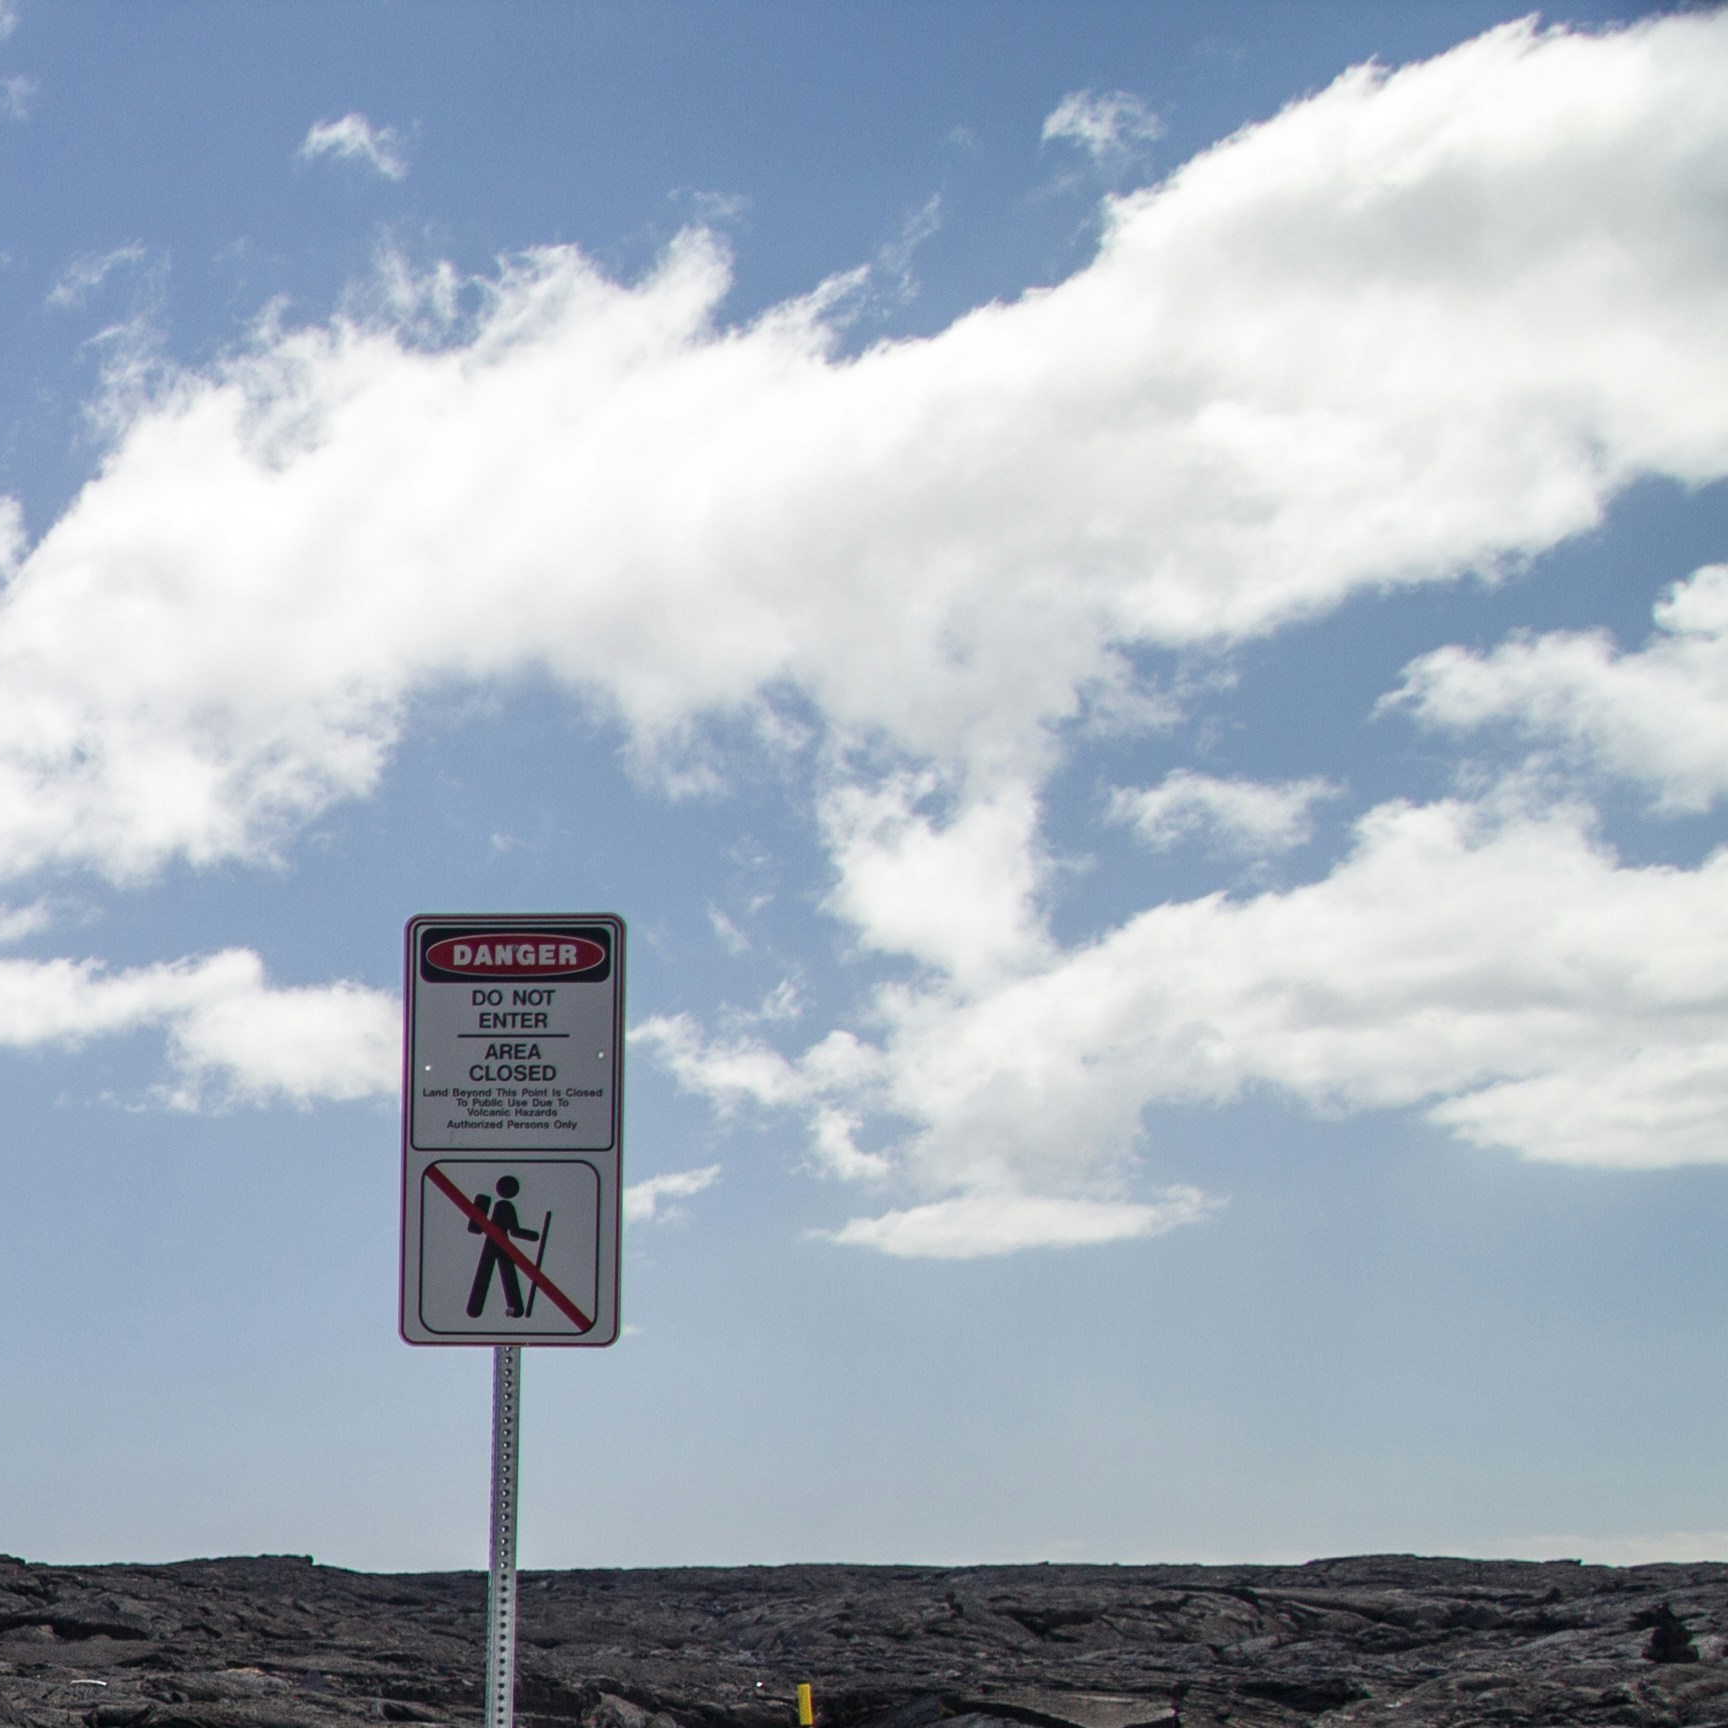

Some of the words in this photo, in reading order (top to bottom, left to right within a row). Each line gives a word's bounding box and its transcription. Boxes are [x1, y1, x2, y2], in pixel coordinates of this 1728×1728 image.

[452, 944, 577, 966] DANGER
[472, 989, 503, 1006] DO
[512, 989, 556, 1006] NOT
[479, 1012, 548, 1029] ENTER
[484, 1043, 542, 1060] AREA
[469, 1064, 557, 1082] CLOSED
[422, 1088, 448, 1097] Land
[452, 1088, 492, 1100] Beyond
[496, 1088, 517, 1097] This
[521, 1088, 548, 1097] Point
[552, 1088, 561, 1097] Is
[565, 1088, 603, 1097] Closed
[456, 1098, 468, 1108] To
[472, 1098, 503, 1108] Public
[507, 1098, 528, 1108] Use
[532, 1098, 553, 1108] Due
[557, 1098, 569, 1108] To
[467, 1108, 510, 1117] Volcanic
[514, 1108, 558, 1117] Hazards
[447, 1120, 503, 1129] Authorized
[507, 1120, 550, 1129] Persons
[553, 1120, 578, 1131] Only
